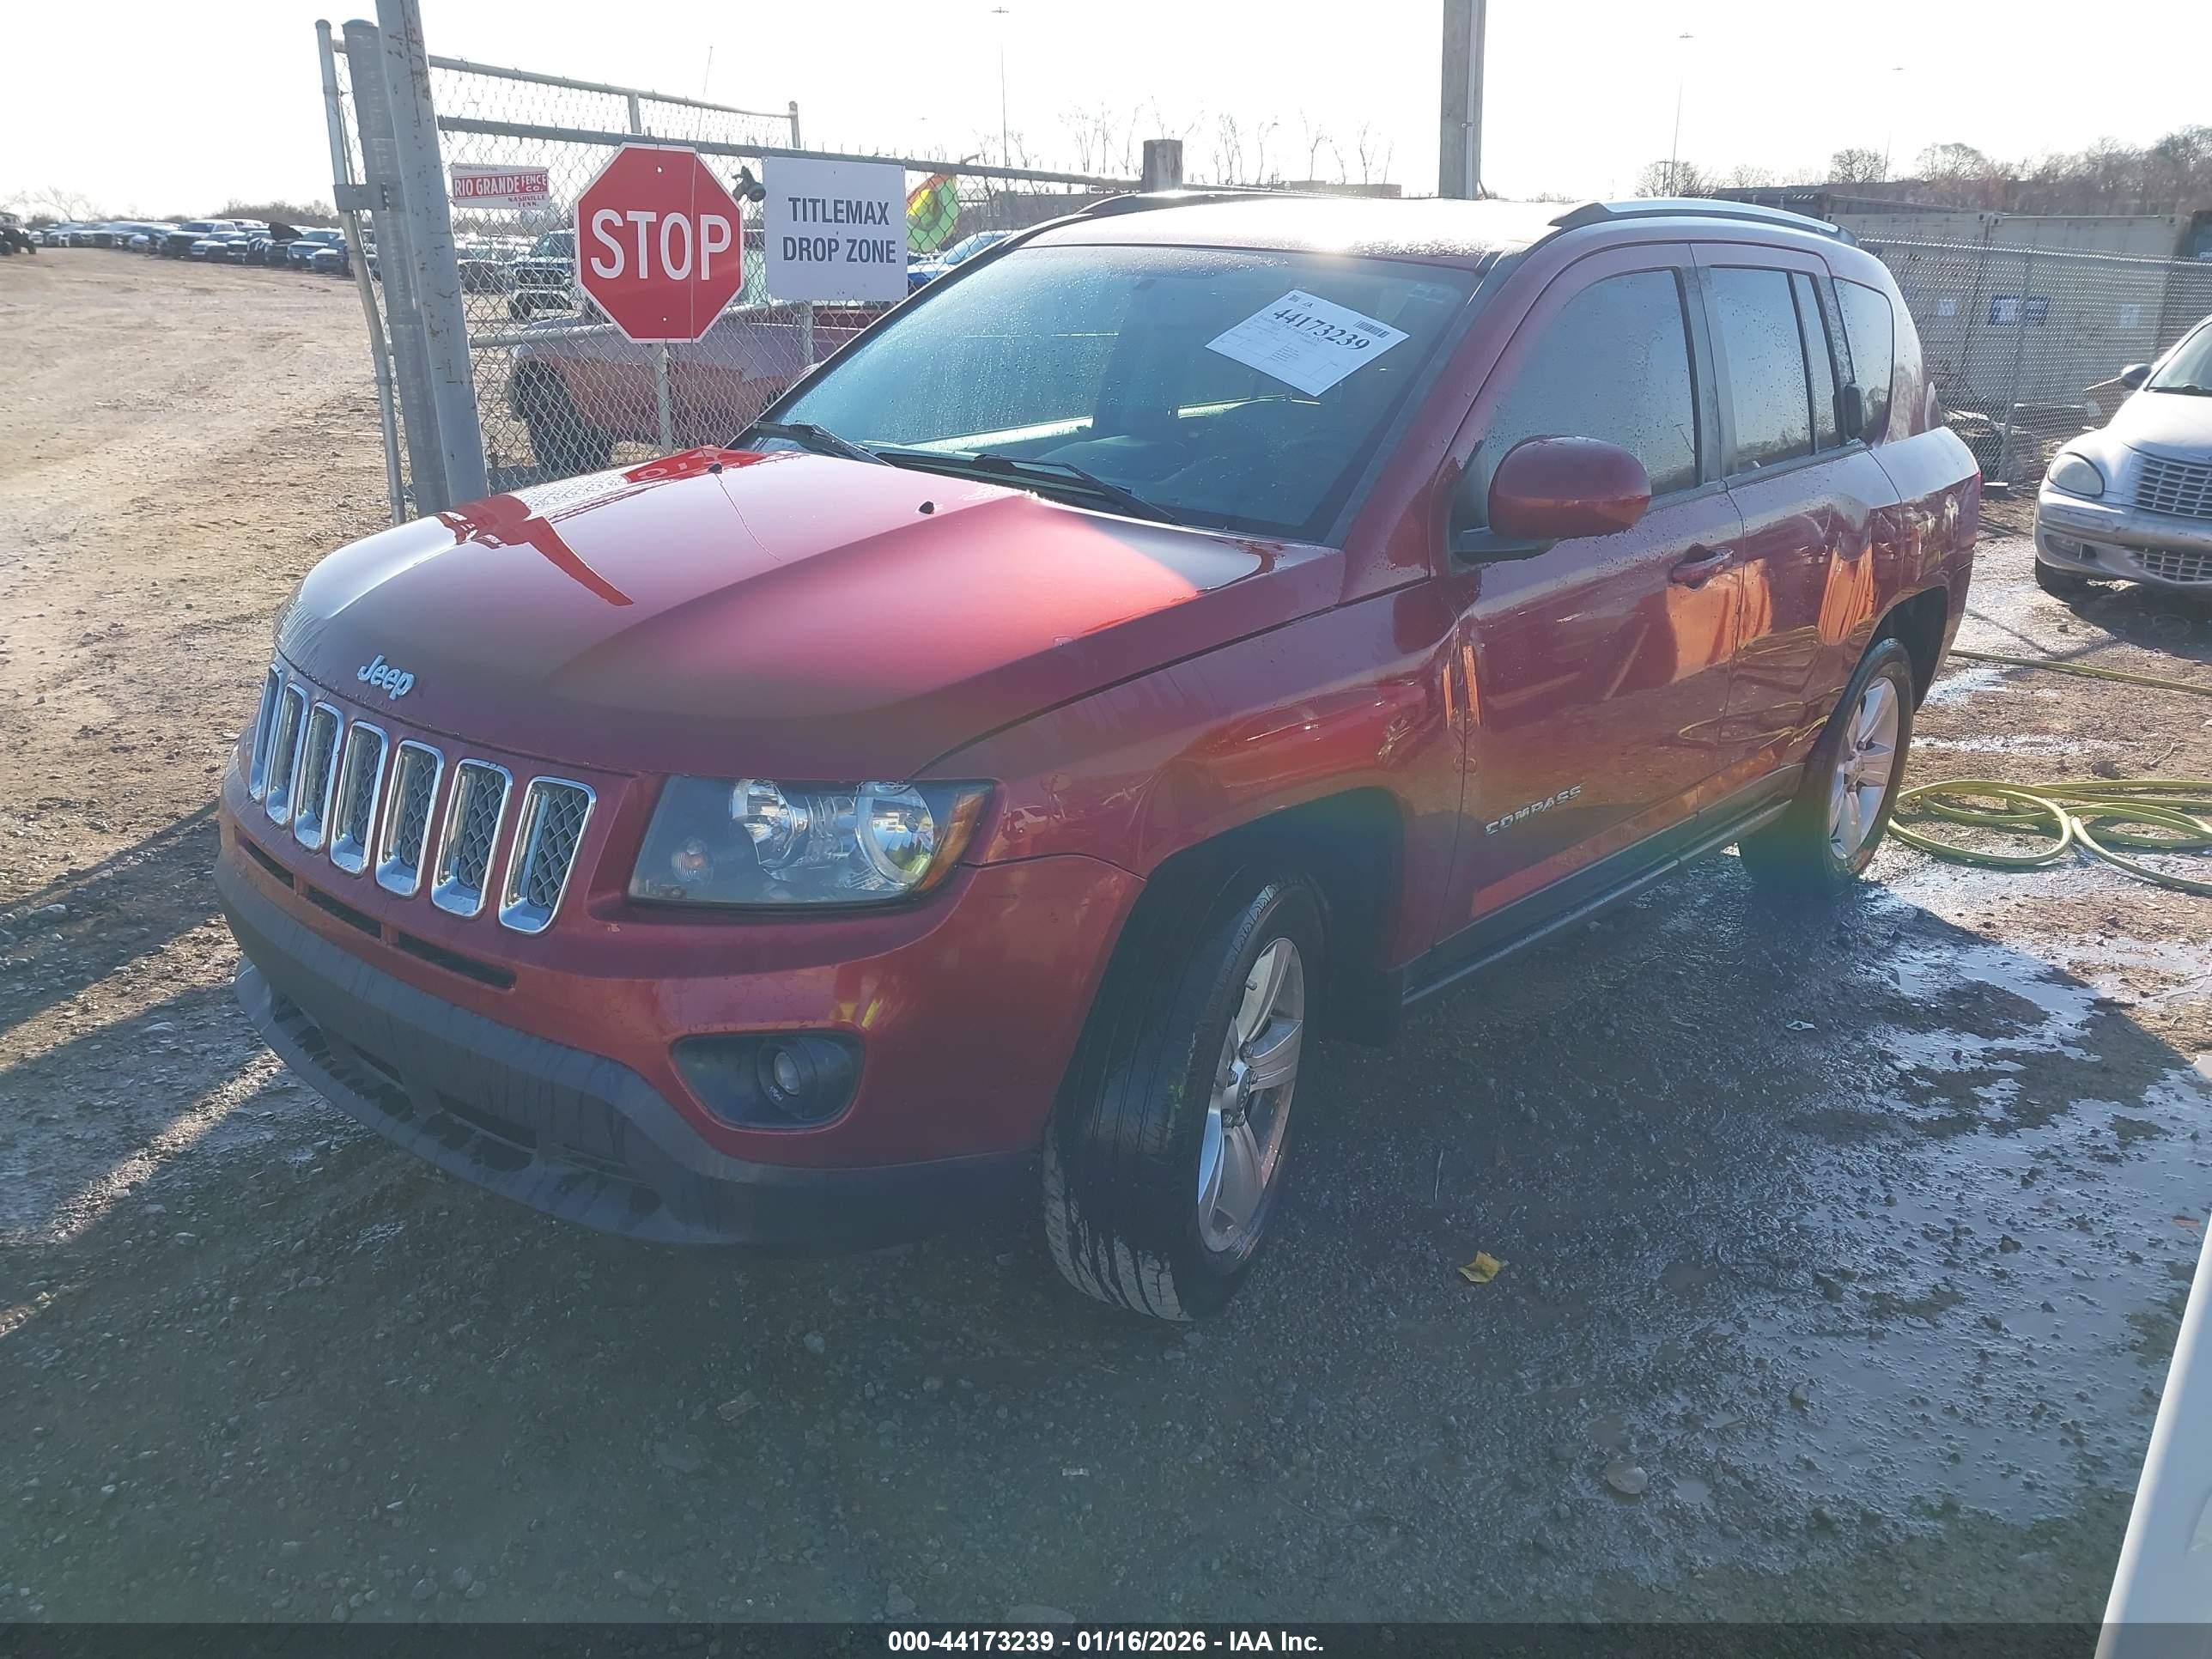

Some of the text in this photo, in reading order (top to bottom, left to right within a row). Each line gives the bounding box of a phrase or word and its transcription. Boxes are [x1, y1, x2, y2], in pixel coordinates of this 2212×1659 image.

[454, 173, 548, 197] RIO GRANDE FENCE
[787, 197, 890, 226] TITLEMAX
[590, 209, 732, 281] STOP
[782, 236, 896, 264] DROP ZONE
[1272, 307, 1371, 351] 44173239
[356, 654, 416, 701] Jeep
[1485, 782, 1585, 836] COMPASS
